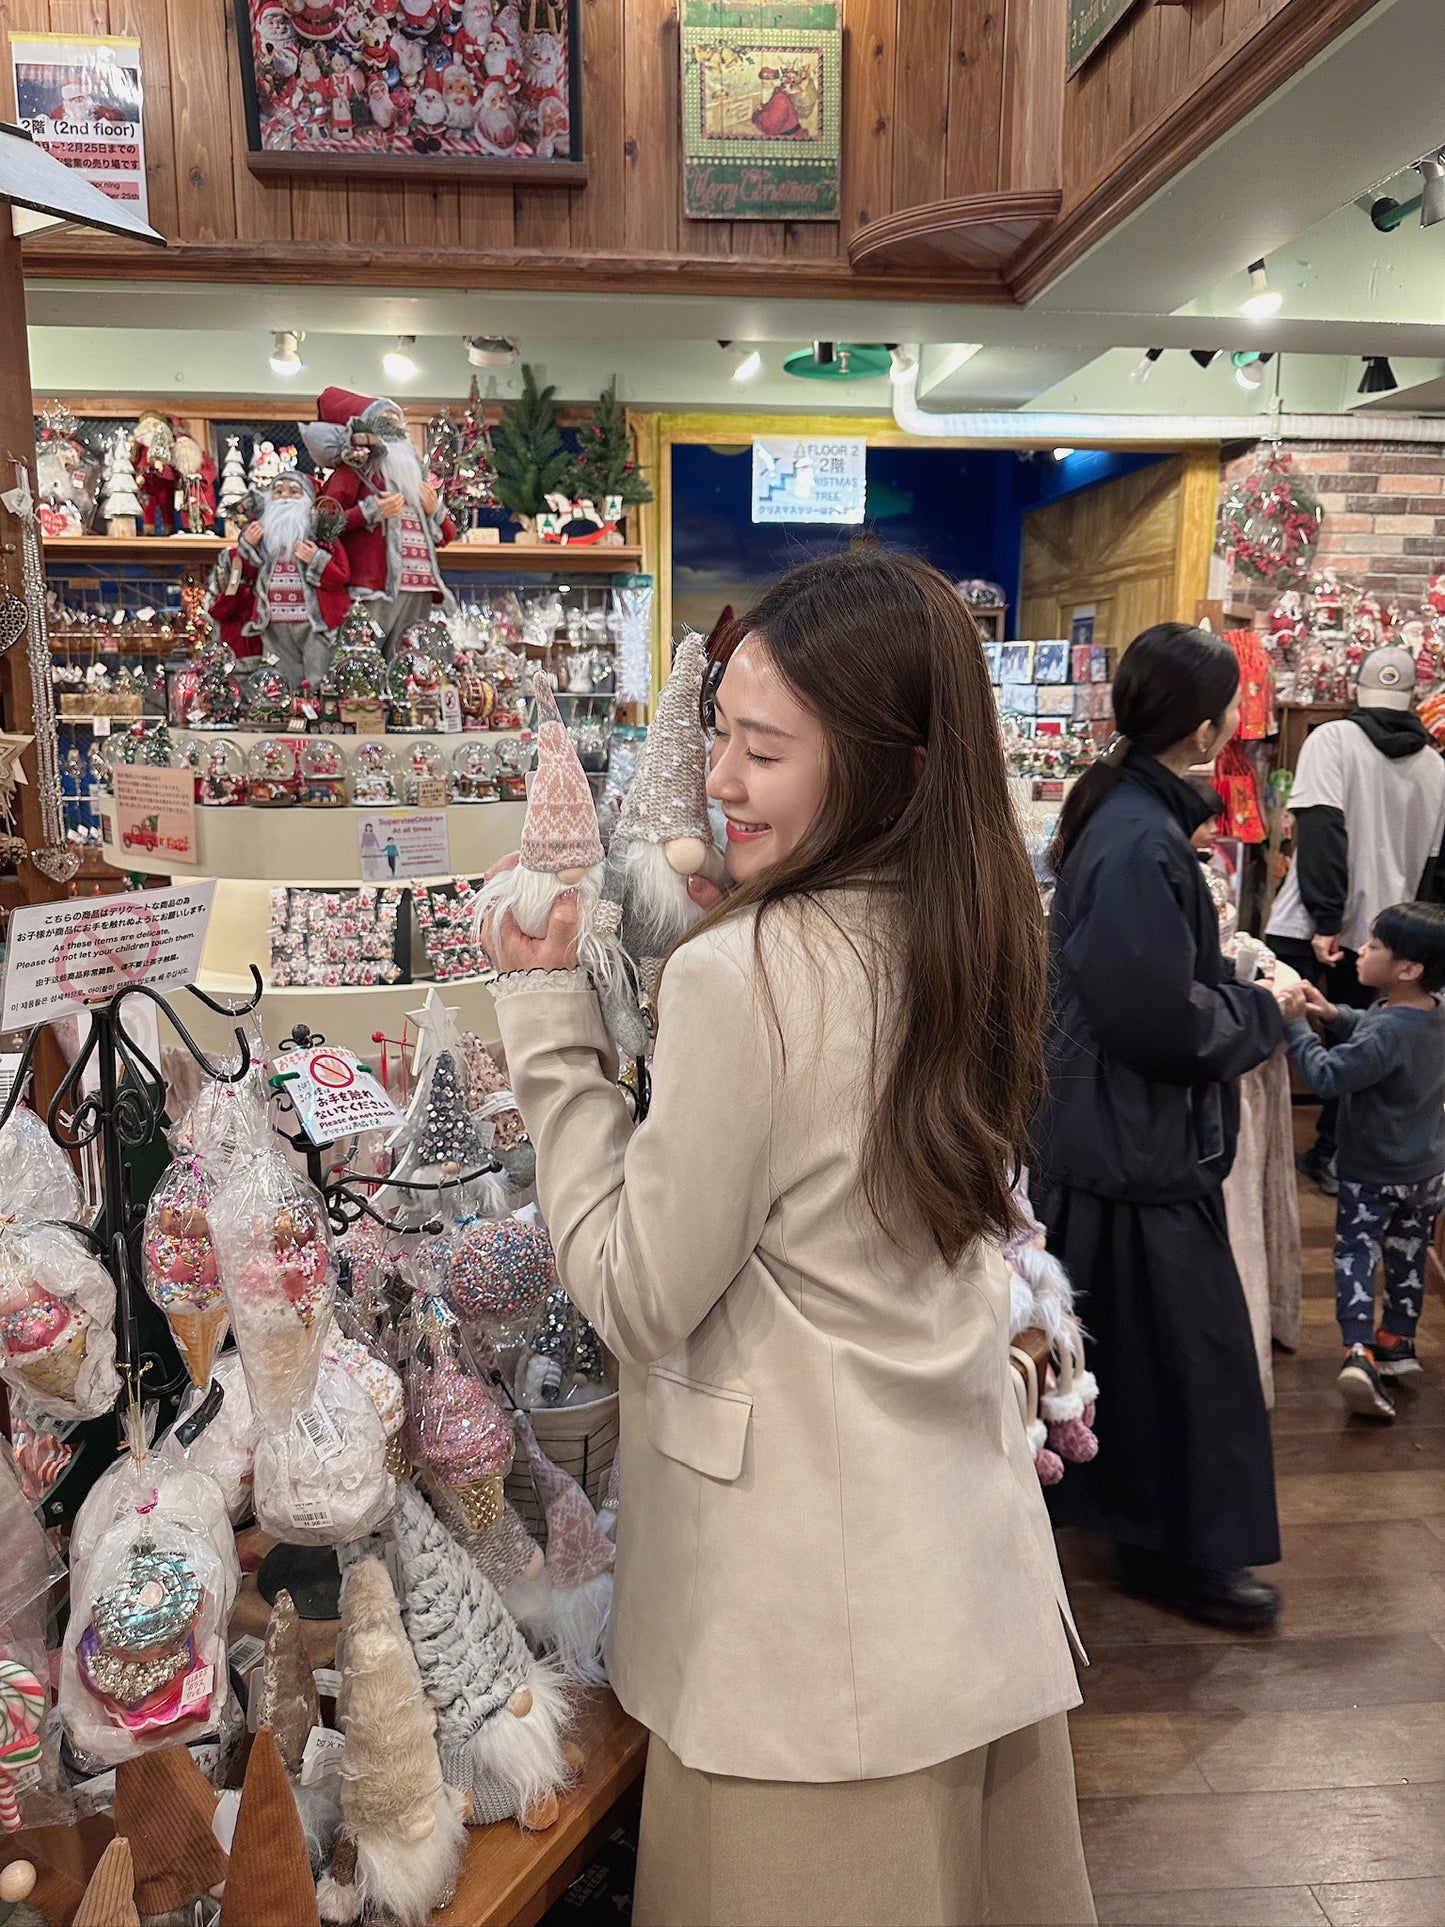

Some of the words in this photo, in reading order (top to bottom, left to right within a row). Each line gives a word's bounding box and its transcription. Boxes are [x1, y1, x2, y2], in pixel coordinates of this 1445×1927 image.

[94, 122, 135, 138] floor)
[687, 166, 738, 210] Merry
[740, 168, 819, 202] Christmas
[808, 445, 847, 456] FLOOR
[852, 446, 859, 456] 2
[53, 944, 65, 952] As
[67, 939, 92, 951] these
[94, 936, 118, 947] items
[120, 934, 134, 942] are
[136, 927, 171, 940] delicate,
[16, 959, 46, 970] Please
[49, 954, 60, 963] do
[62, 953, 78, 962] not
[79, 951, 91, 959] let
[93, 948, 113, 959] your
[115, 941, 149, 954] children
[151, 936, 173, 947] touch
[10, 1003, 19, 1011] 이
[317, 1089, 374, 1108] お手を触れ
[314, 1101, 389, 1120] ないでください
[319, 1117, 347, 1129] Please
[359, 1112, 373, 1120] not
[374, 1109, 396, 1118] touch
